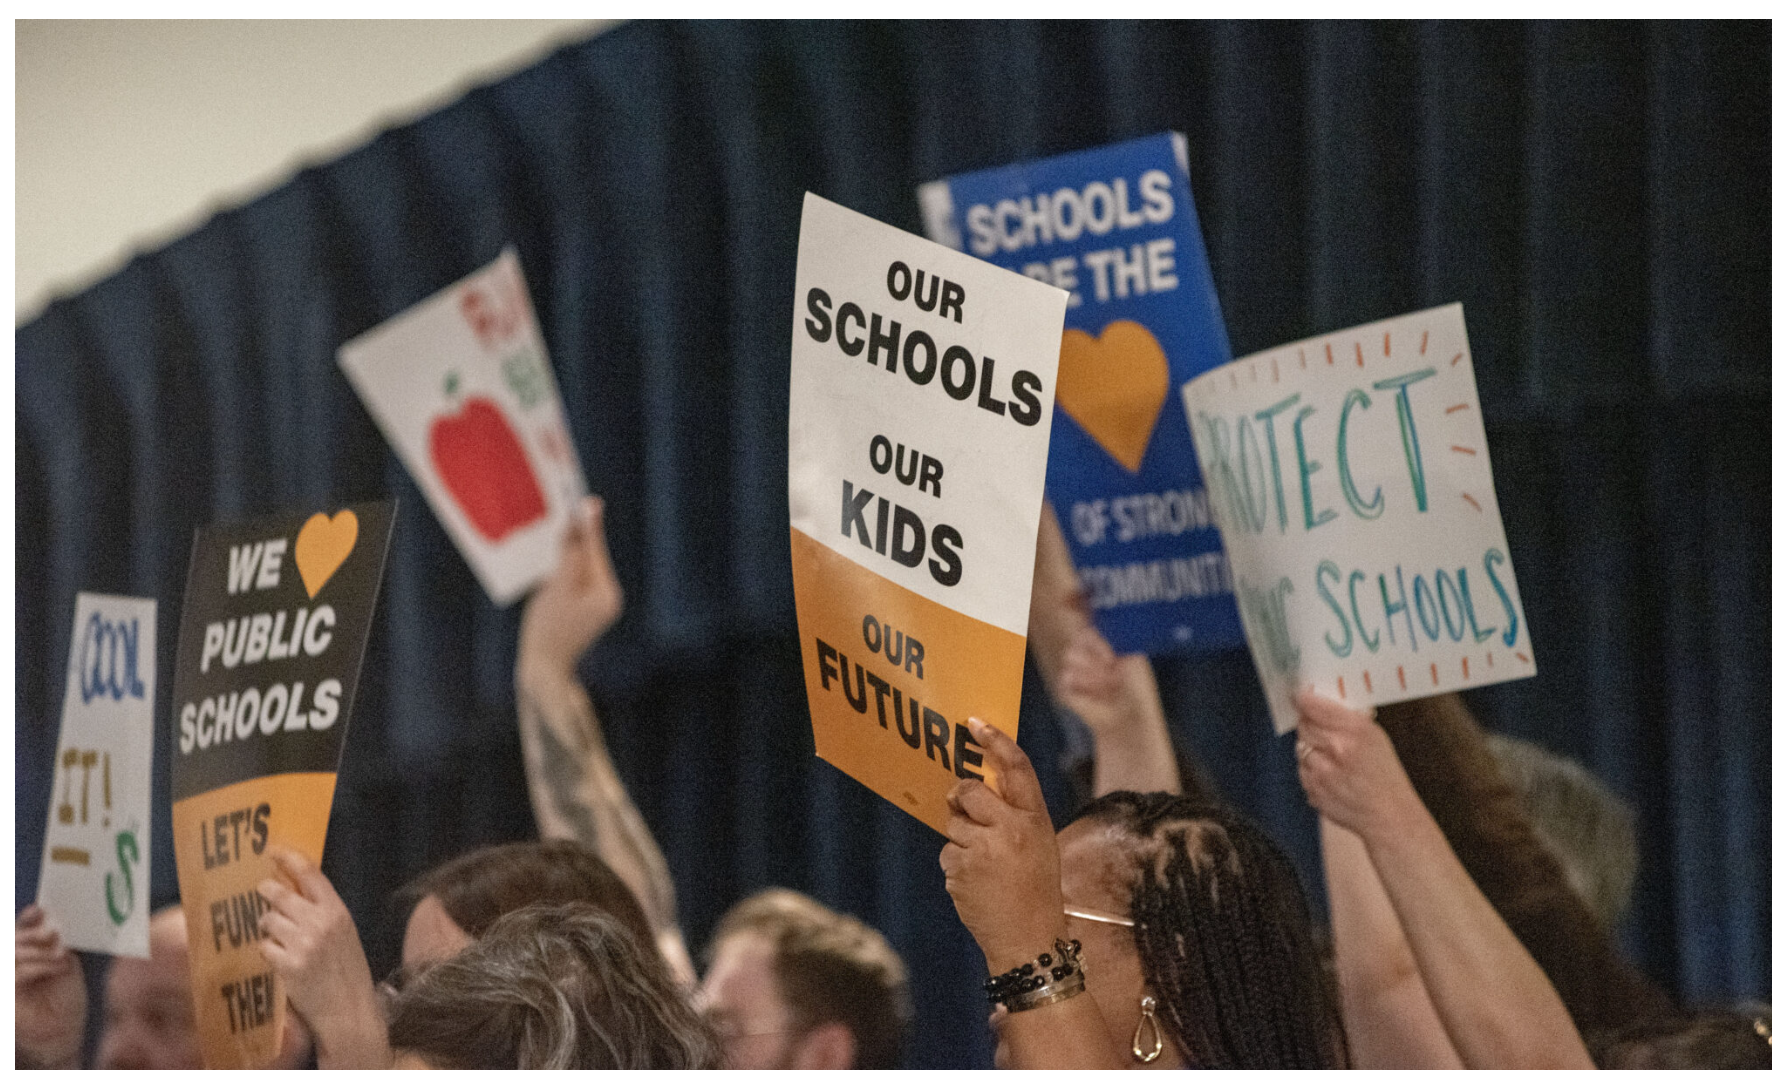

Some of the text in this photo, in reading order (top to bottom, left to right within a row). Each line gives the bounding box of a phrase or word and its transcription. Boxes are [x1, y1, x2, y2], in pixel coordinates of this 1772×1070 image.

[966, 168, 1175, 257] SCHOOLS
[886, 260, 966, 324] OUR
[1084, 237, 1180, 302] THE
[804, 287, 1043, 427] SCHOOLS
[869, 433, 945, 499] OUR
[840, 478, 964, 588] KIDS
[1111, 489, 1209, 543] STRON
[227, 537, 288, 595] WE
[1315, 547, 1518, 658] SCHOOLS
[200, 605, 336, 674] PUBLIC
[862, 614, 925, 680] OUR
[179, 678, 342, 755] SCHOOLS
[815, 636, 985, 783] FUTURE
[57, 747, 112, 828] IT!
[201, 802, 272, 871] LET'S
